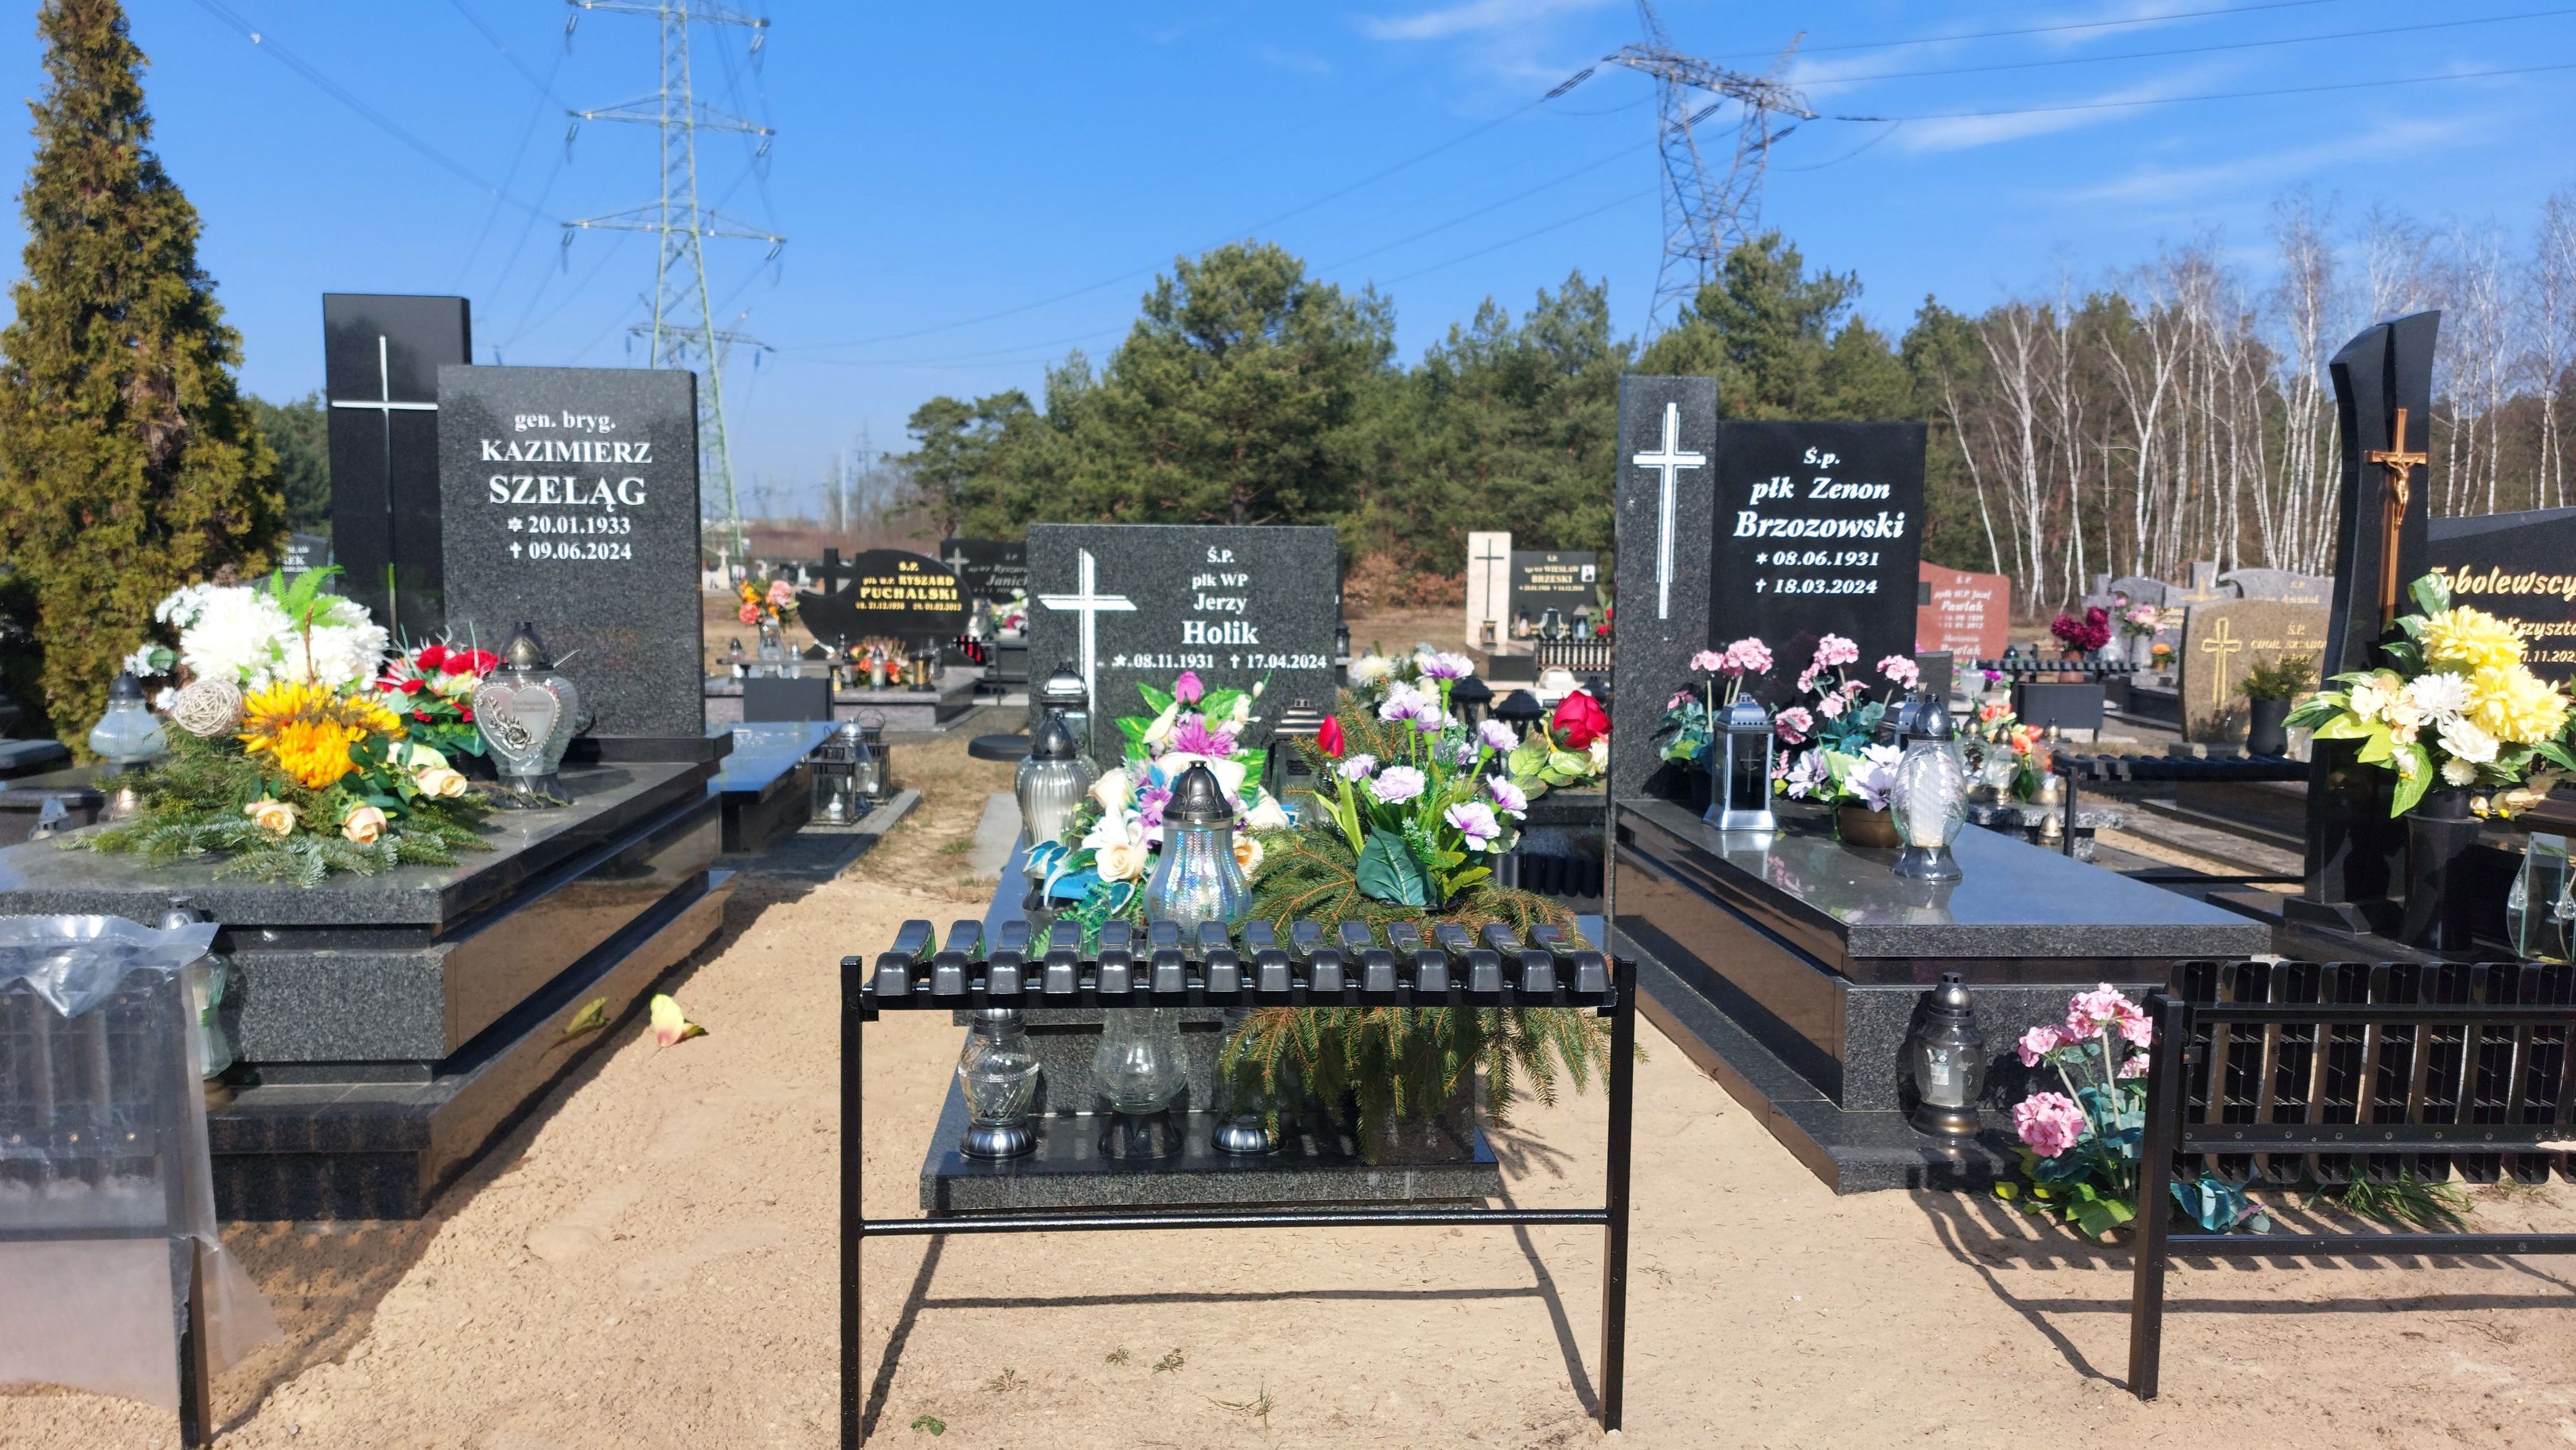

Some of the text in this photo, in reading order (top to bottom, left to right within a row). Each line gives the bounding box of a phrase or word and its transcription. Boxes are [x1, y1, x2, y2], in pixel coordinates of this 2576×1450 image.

[514, 411, 616, 433] gen. bryg.
[480, 439, 653, 463] KAZIMIERZ
[1803, 446, 1841, 469] Ś.p.
[489, 474, 647, 513] SZELĄG
[1750, 476, 1891, 505] płk Zenon
[528, 516, 631, 535] 20.01.1933
[1733, 510, 1906, 538] Brzozowski
[528, 542, 633, 560] 09.06.2024
[1207, 546, 1235, 563] Ś.P.
[1772, 551, 1880, 566] 08.06.1931
[898, 575, 955, 587] RYSZARD
[1220, 574, 1249, 587] WP
[1774, 579, 1879, 594] 18.03.2024
[859, 587, 958, 600] PUCHALSKI
[1194, 593, 1248, 614] Jerzy
[1940, 600, 1984, 612] Pawlak
[1181, 621, 1259, 644] Holik
[1133, 654, 1328, 669] 08.11.1931 17.04.2024
